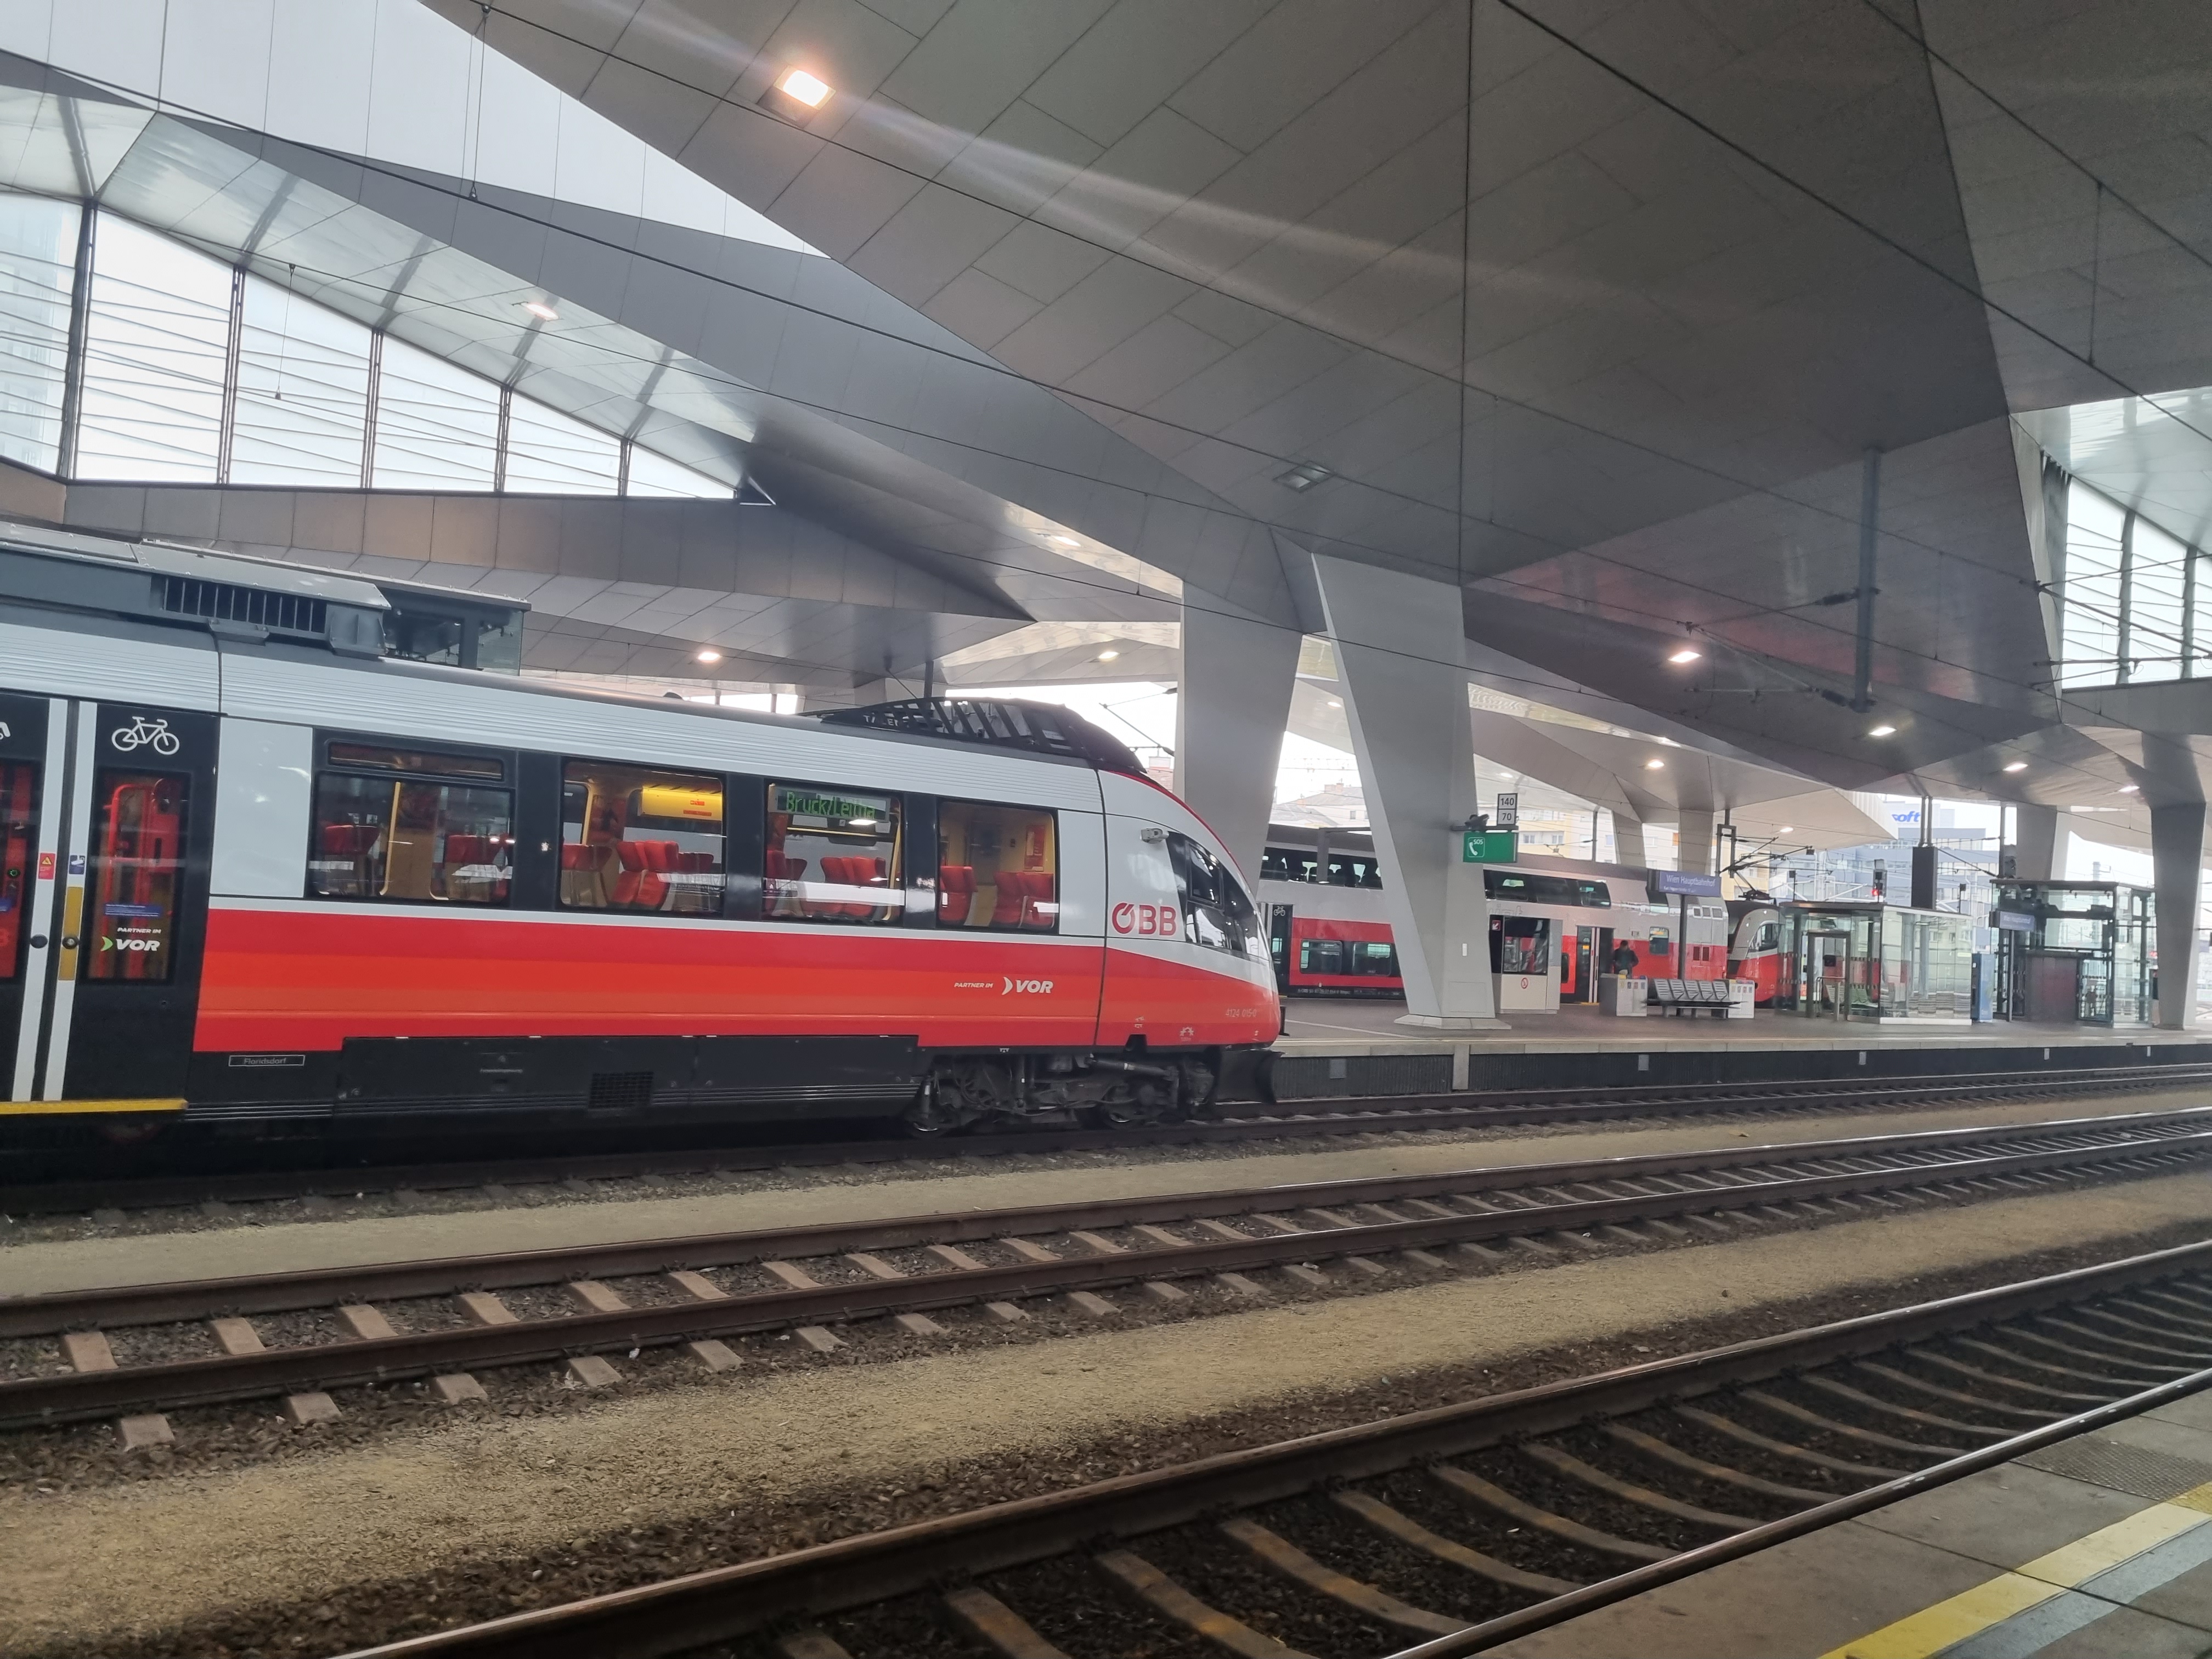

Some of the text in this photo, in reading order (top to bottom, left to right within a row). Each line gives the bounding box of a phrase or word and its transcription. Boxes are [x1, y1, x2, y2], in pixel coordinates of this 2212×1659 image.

[1502, 812, 1512, 821] 70
[1666, 874, 1716, 887] Wien Hauptbahnhof
[116, 939, 160, 951] VOR
[1015, 979, 1054, 994] VOR
